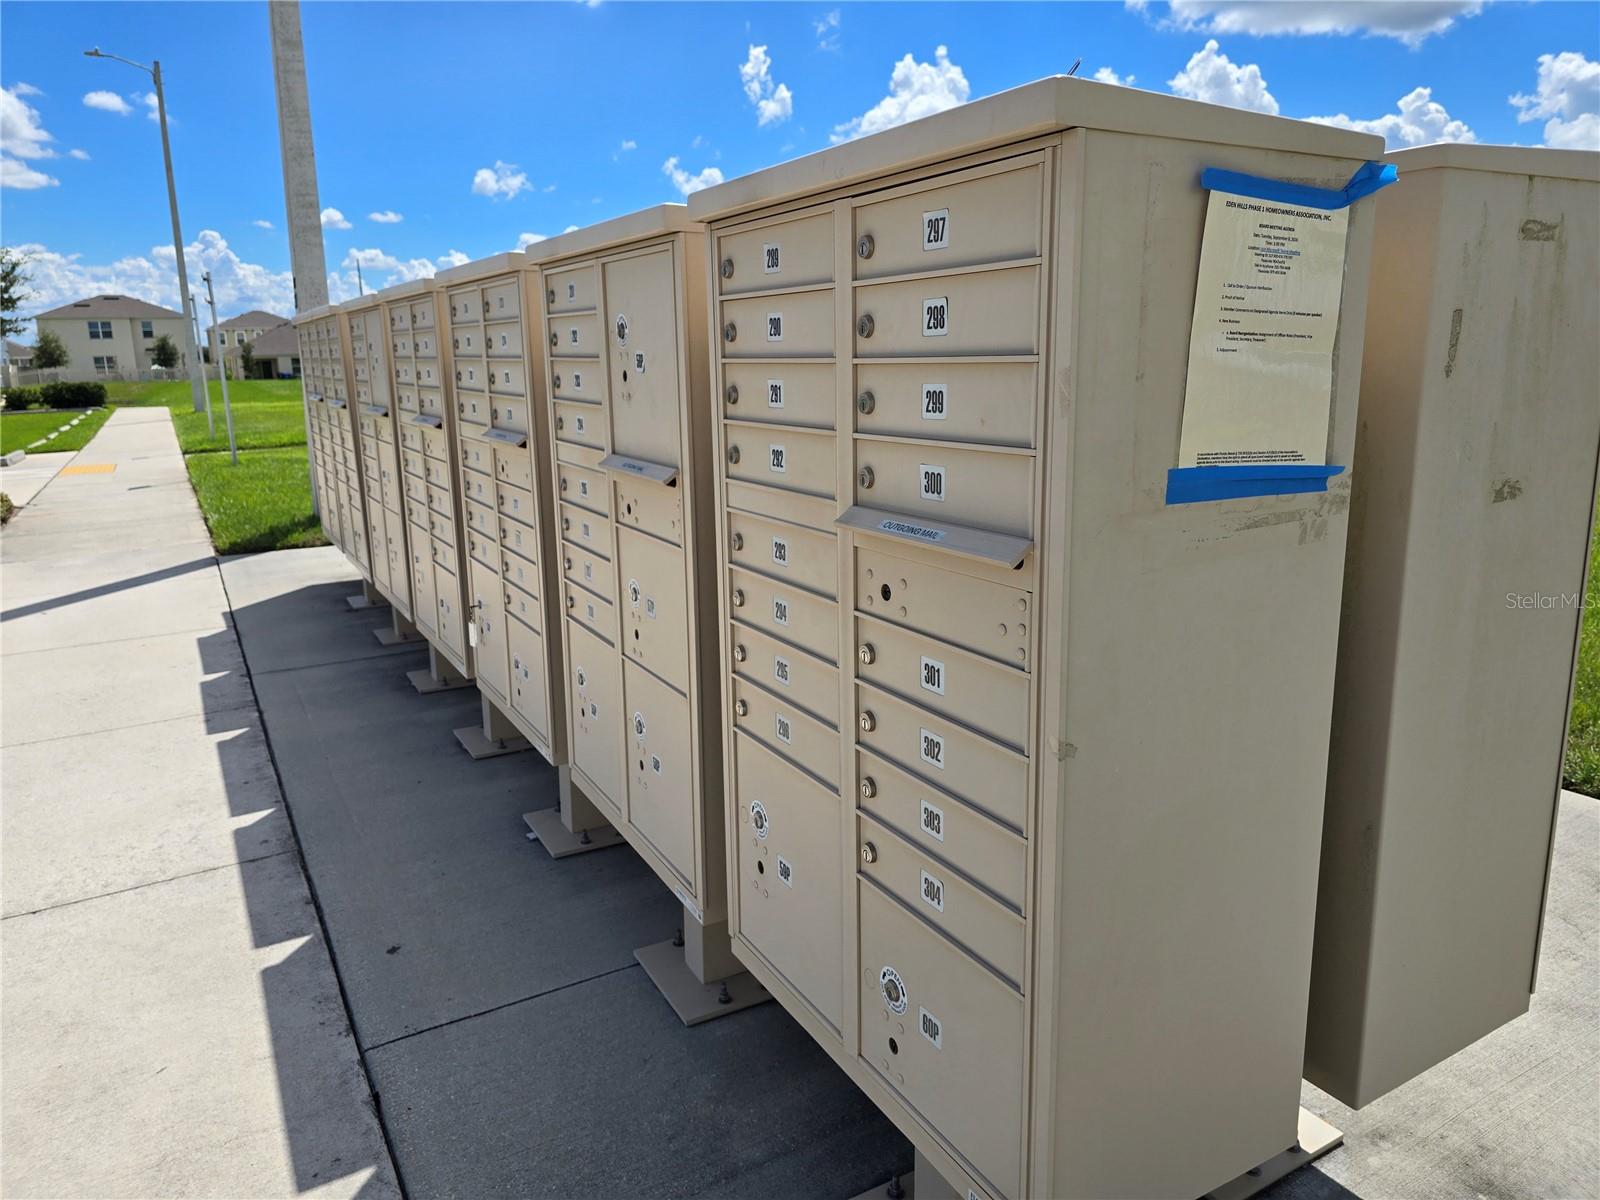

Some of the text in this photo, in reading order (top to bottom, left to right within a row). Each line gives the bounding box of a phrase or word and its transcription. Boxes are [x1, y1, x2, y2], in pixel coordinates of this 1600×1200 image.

[1226, 200, 1236, 208] EDEN
[1237, 202, 1248, 210] HILLS
[1248, 204, 1262, 212] PHASE
[1265, 207, 1296, 216] HOMEOWNERS
[1296, 211, 1322, 220] ASSOCIATION,
[927, 217, 946, 244] 297
[766, 248, 779, 268] 289
[769, 317, 781, 337] 290
[927, 305, 945, 329] 298
[770, 384, 781, 403] 291
[926, 390, 944, 414] 299
[772, 449, 783, 468] 292
[924, 471, 942, 495] 300
[883, 521, 939, 539] OUTGOING MAIL
[774, 541, 786, 562] 293
[775, 602, 787, 622] 294
[924, 663, 940, 688] 301
[924, 735, 941, 763] 302
[924, 807, 940, 835] 303
[924, 877, 941, 905] 304
[886, 969, 901, 986] OPEN
[923, 1013, 939, 1041] 60P
